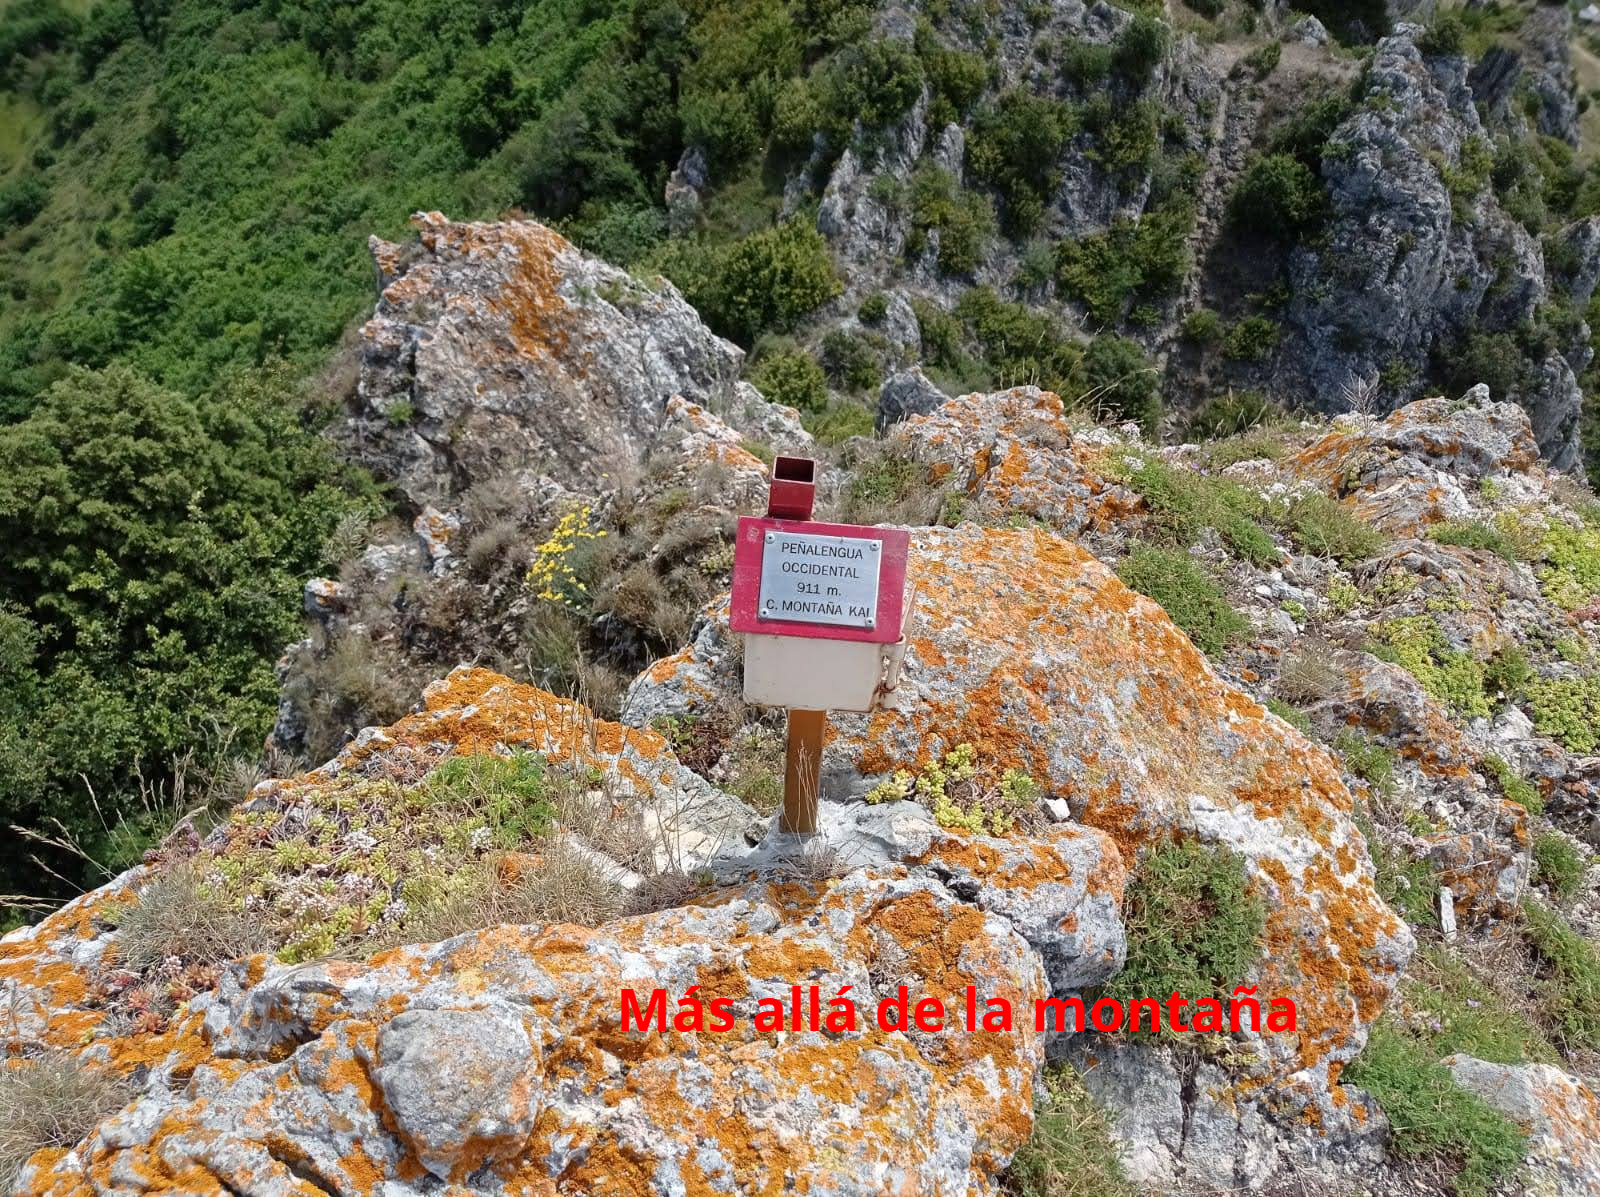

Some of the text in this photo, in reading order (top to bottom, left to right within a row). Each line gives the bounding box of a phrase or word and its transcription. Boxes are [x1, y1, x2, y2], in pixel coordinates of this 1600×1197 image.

[781, 541, 863, 560] PEÑALENGUA
[782, 562, 860, 579] OCCIDENTAL
[797, 582, 842, 597] 911 m.
[766, 599, 870, 618] C. MONTAÑA KAI
